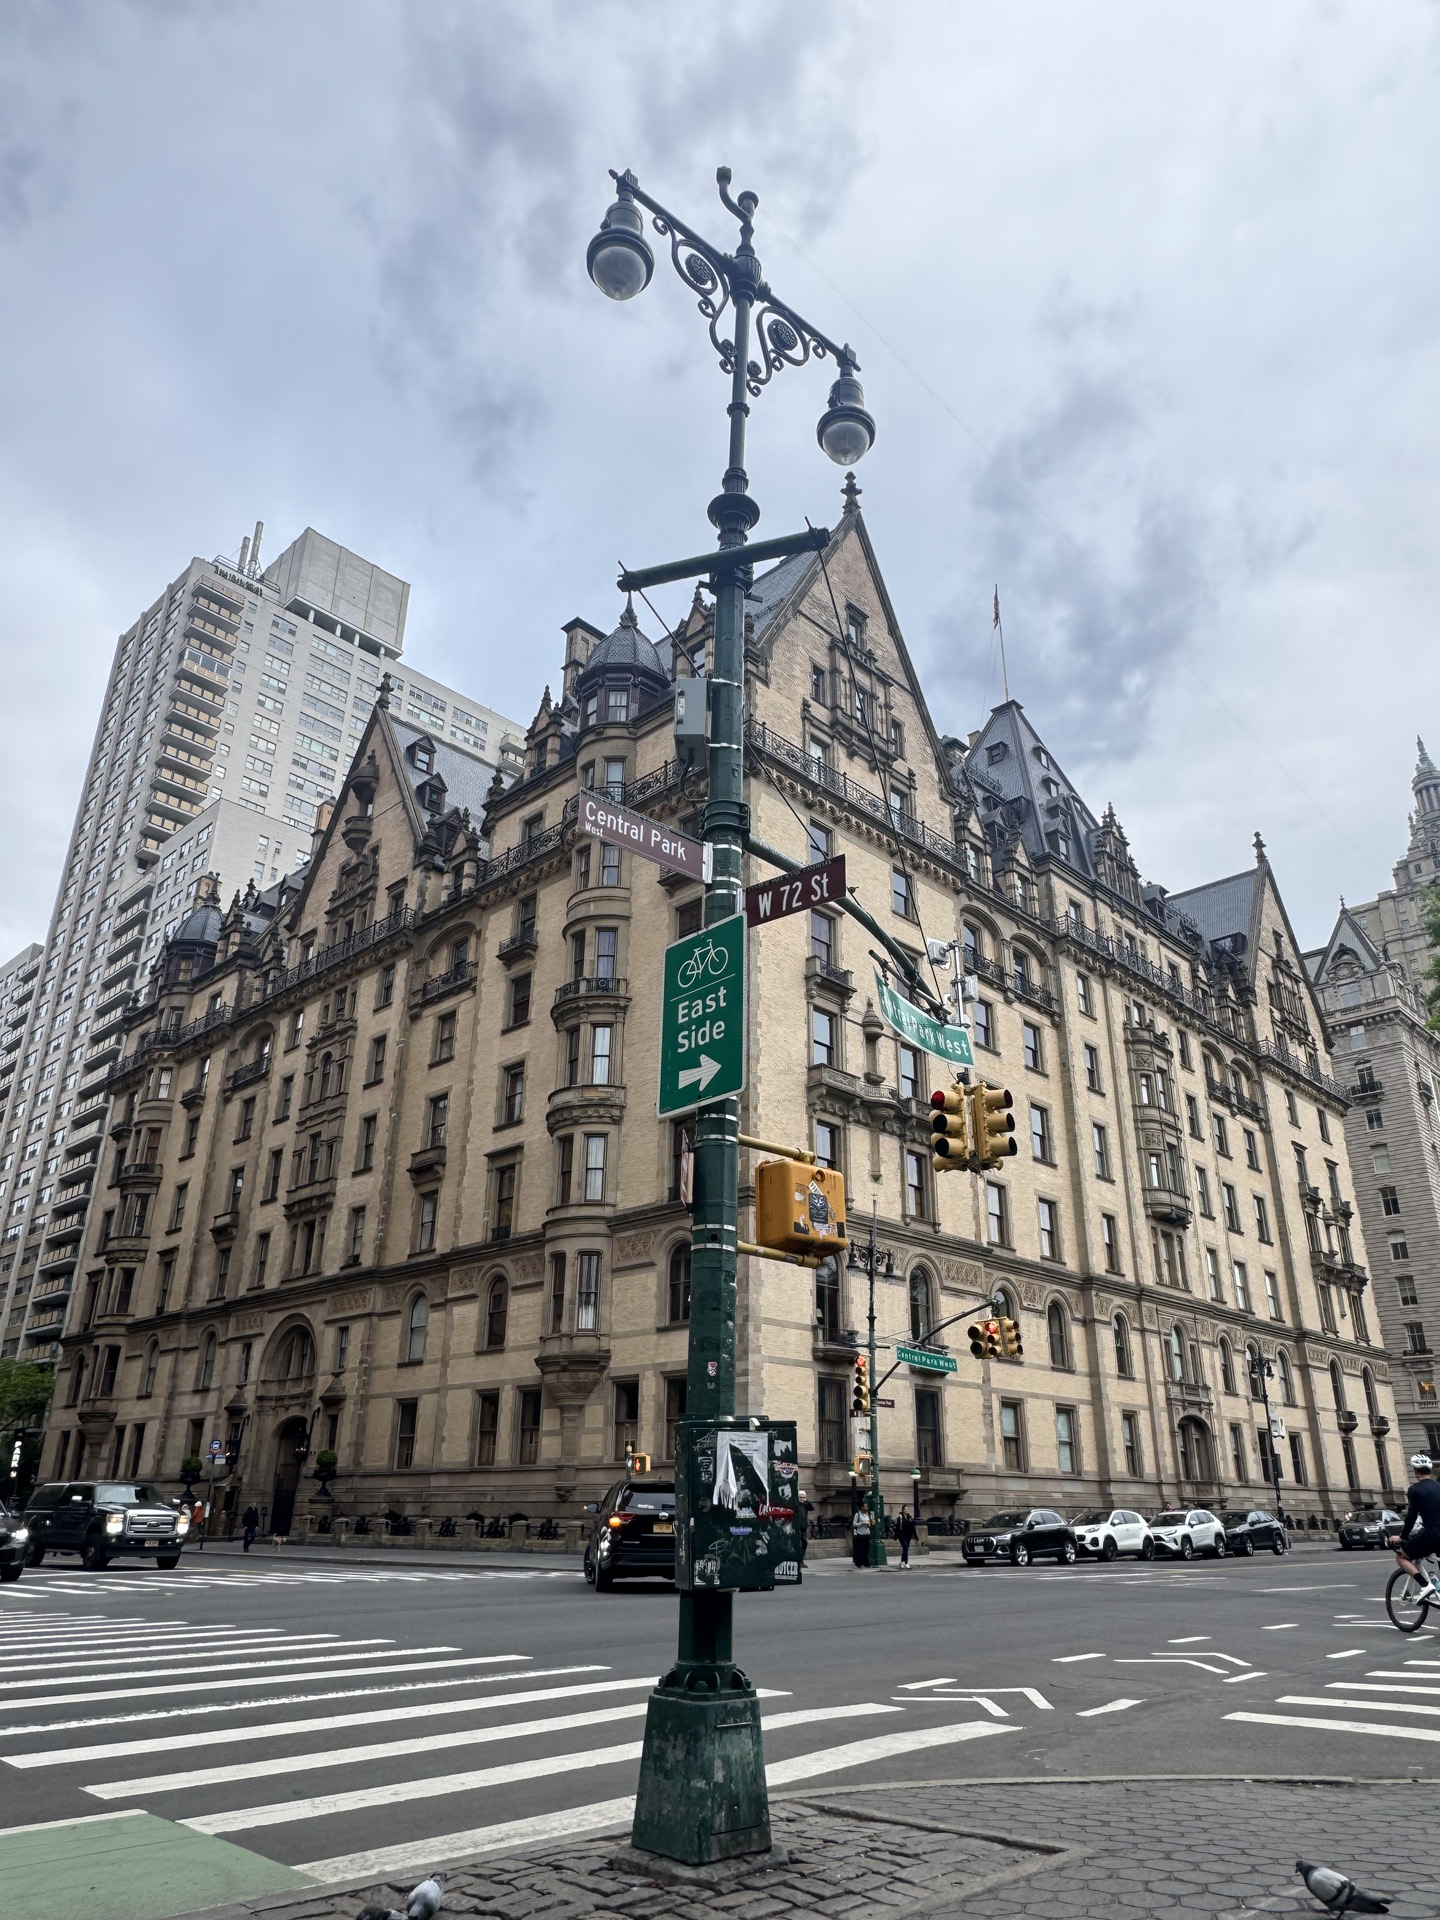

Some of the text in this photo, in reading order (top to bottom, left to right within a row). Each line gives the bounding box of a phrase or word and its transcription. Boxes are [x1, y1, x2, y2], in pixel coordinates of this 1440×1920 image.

[585, 820, 603, 838] West
[585, 801, 643, 842] Central
[651, 829, 686, 861] Park
[758, 890, 772, 919] W
[780, 881, 802, 911] 72
[810, 872, 829, 901] St
[678, 986, 727, 1024] East
[677, 1020, 725, 1053] Side
[911, 1017, 936, 1046] Park
[936, 1031, 969, 1057] West
[921, 1355, 938, 1366] Park
[939, 1359, 957, 1369] West
[11, 1441, 22, 1468] PARK
